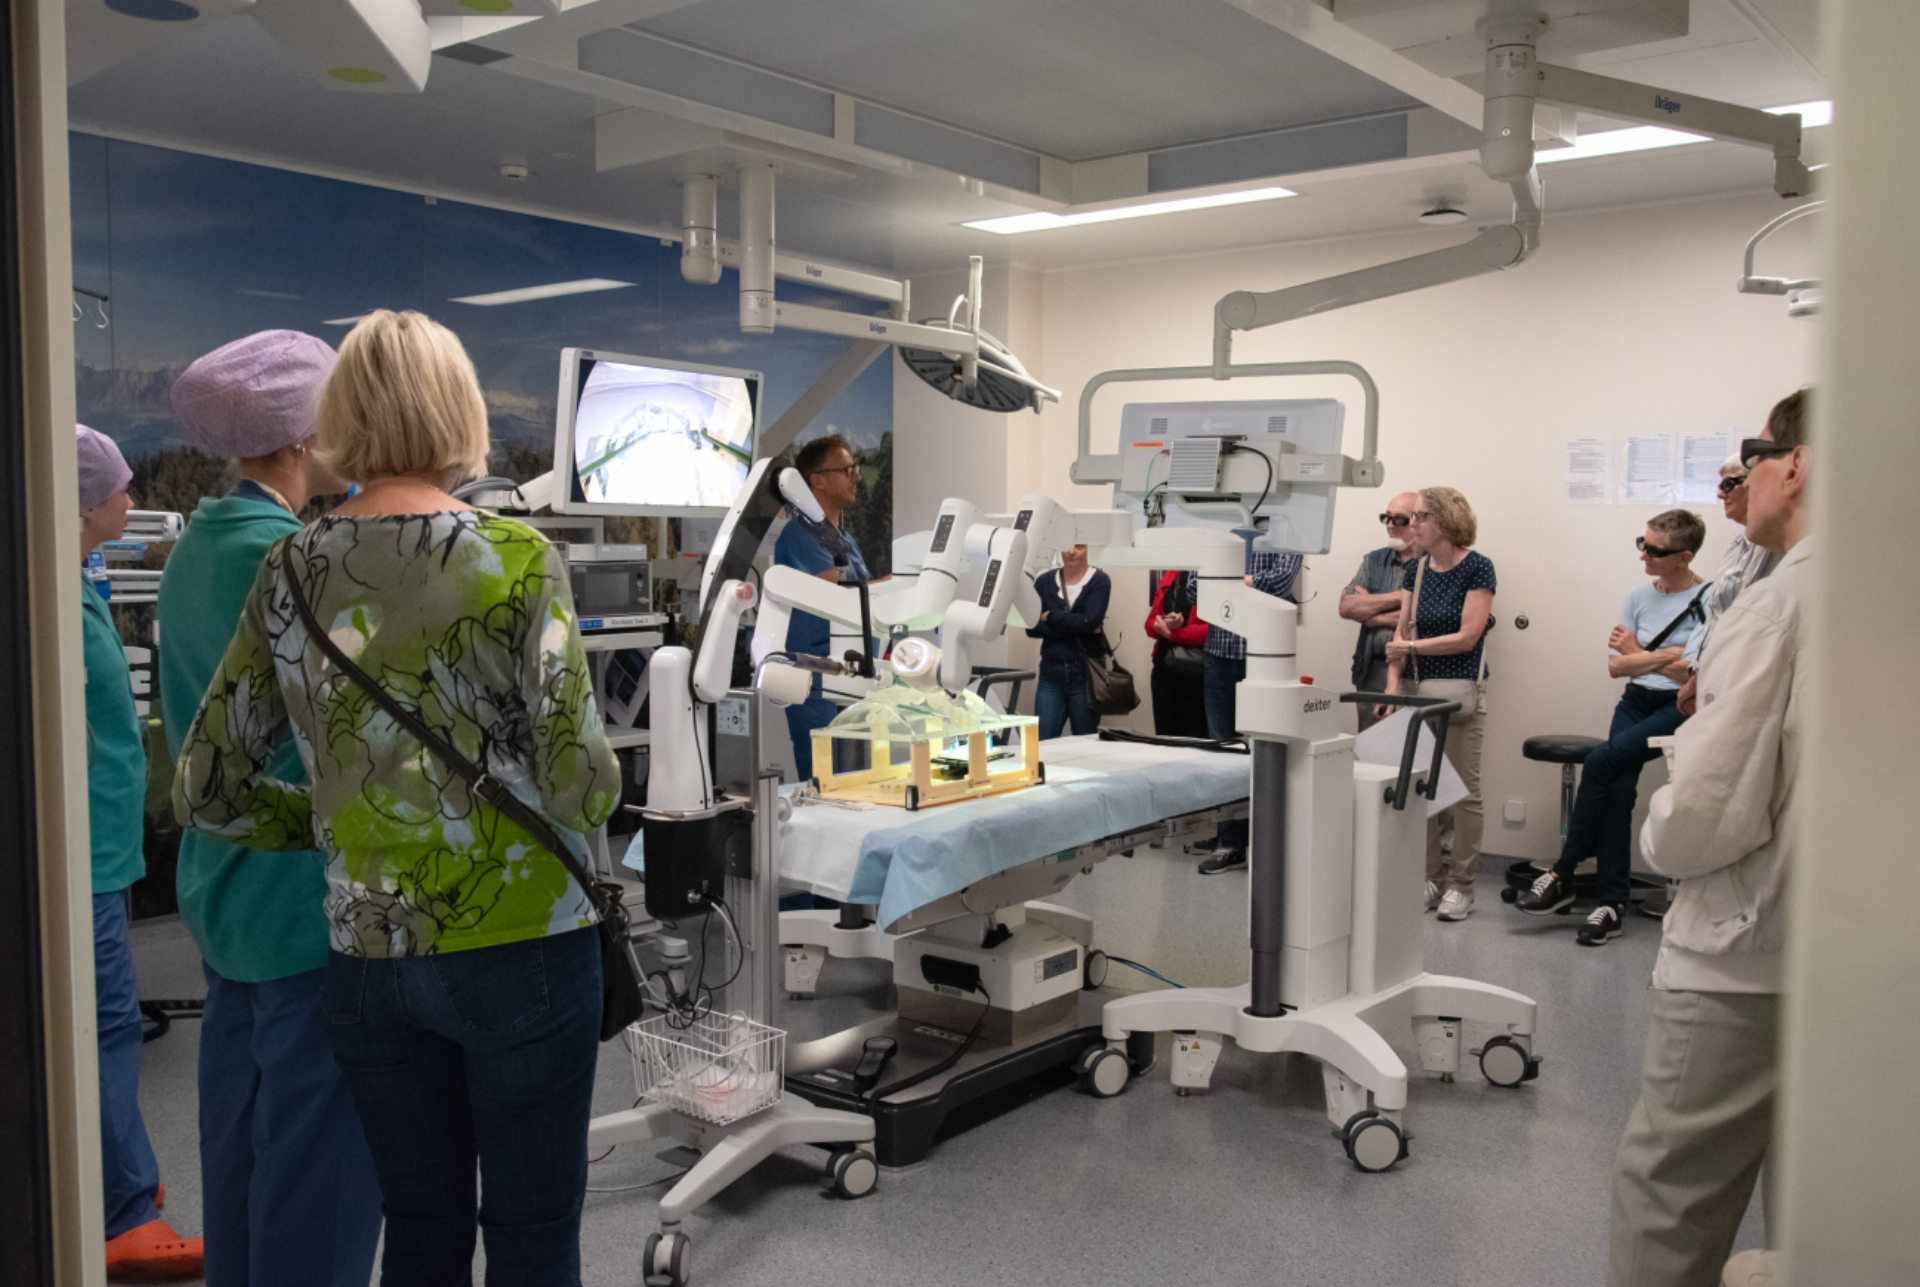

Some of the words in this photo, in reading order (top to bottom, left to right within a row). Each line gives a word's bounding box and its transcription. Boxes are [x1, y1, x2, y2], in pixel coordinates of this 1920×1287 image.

[1655, 95, 1681, 114] Dräger
[1223, 604, 1231, 618] 2
[1303, 698, 1331, 714] dexter
